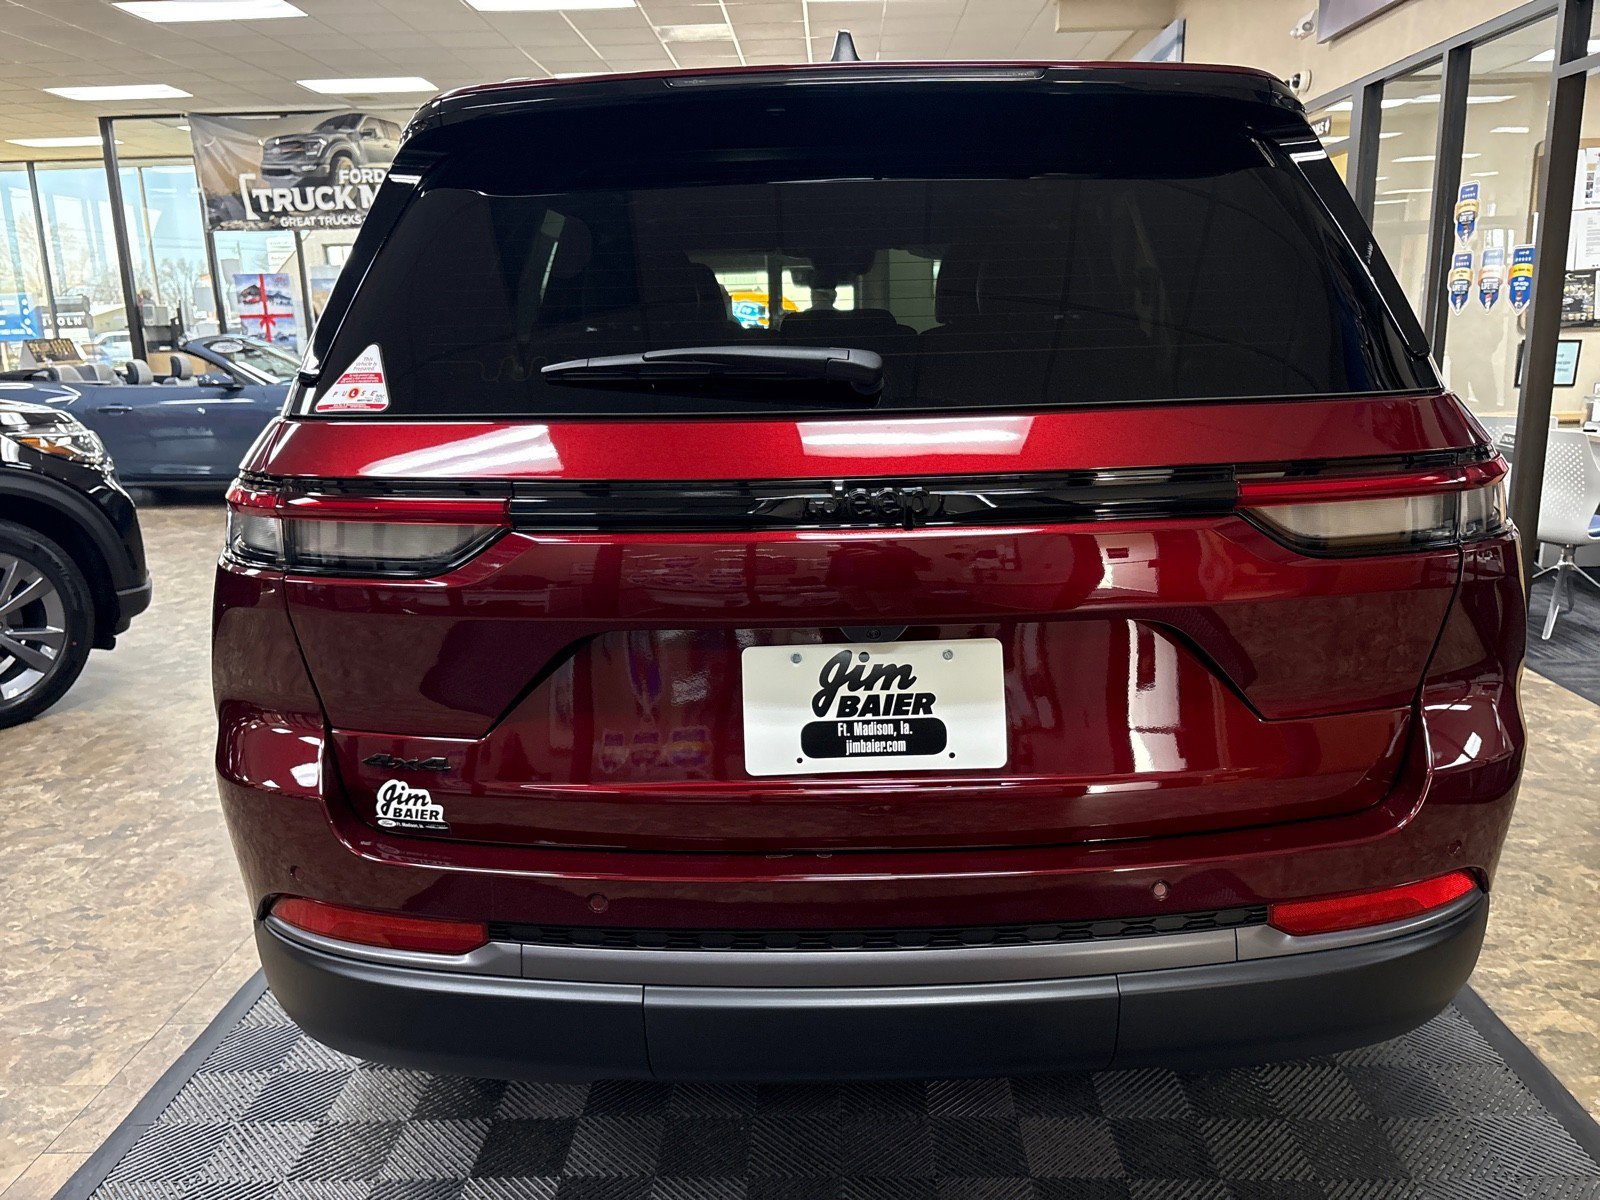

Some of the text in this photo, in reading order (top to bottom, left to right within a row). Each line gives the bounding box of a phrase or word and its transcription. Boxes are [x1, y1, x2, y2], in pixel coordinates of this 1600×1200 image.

[338, 168, 385, 185] FORD
[252, 185, 357, 213] TRUCK
[280, 214, 362, 228] GREAT TRUCKS
[811, 649, 917, 718] Jim
[836, 692, 937, 719] BAIER
[837, 722, 851, 736] Ft.
[853, 721, 898, 737] Madison,
[845, 738, 907, 756] jimbaier.com
[380, 783, 429, 816] Jim
[392, 807, 440, 821] BAIER
